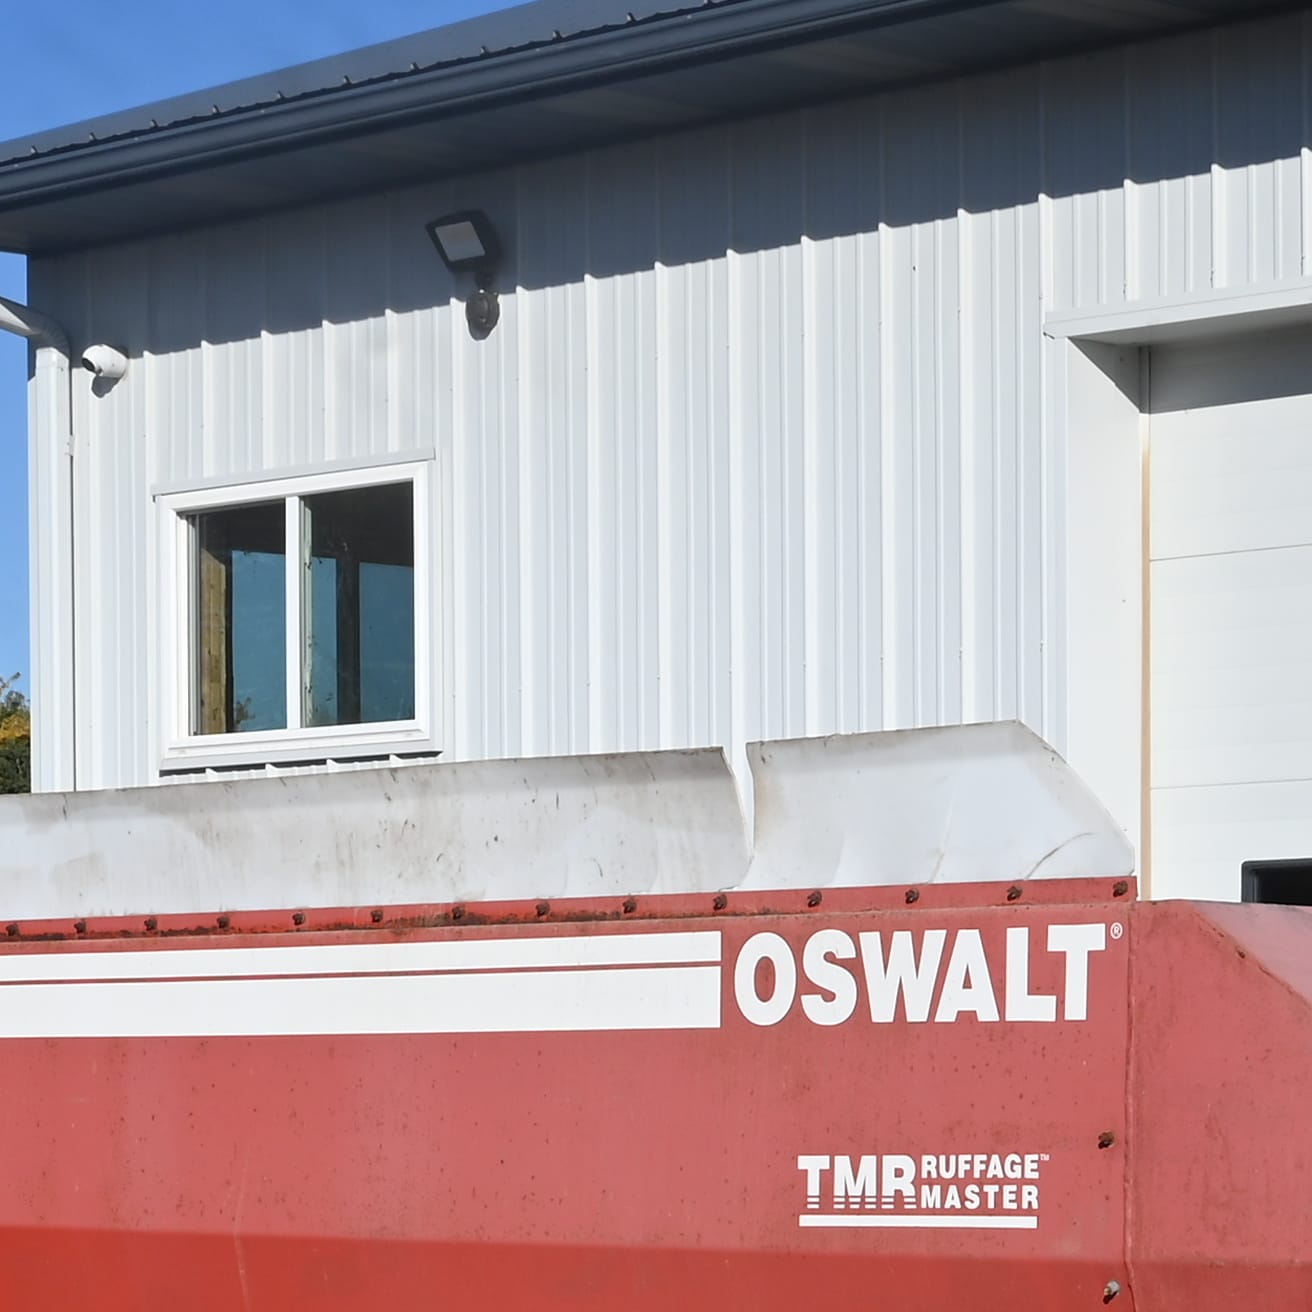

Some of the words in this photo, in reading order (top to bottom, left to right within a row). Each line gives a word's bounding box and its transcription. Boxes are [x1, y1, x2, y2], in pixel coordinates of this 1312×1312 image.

[734, 922, 1107, 1026] OSWALT
[797, 1155, 917, 1209] TMR
[921, 1154, 1040, 1179] RUFFAGE
[920, 1184, 1039, 1210] MASTER
